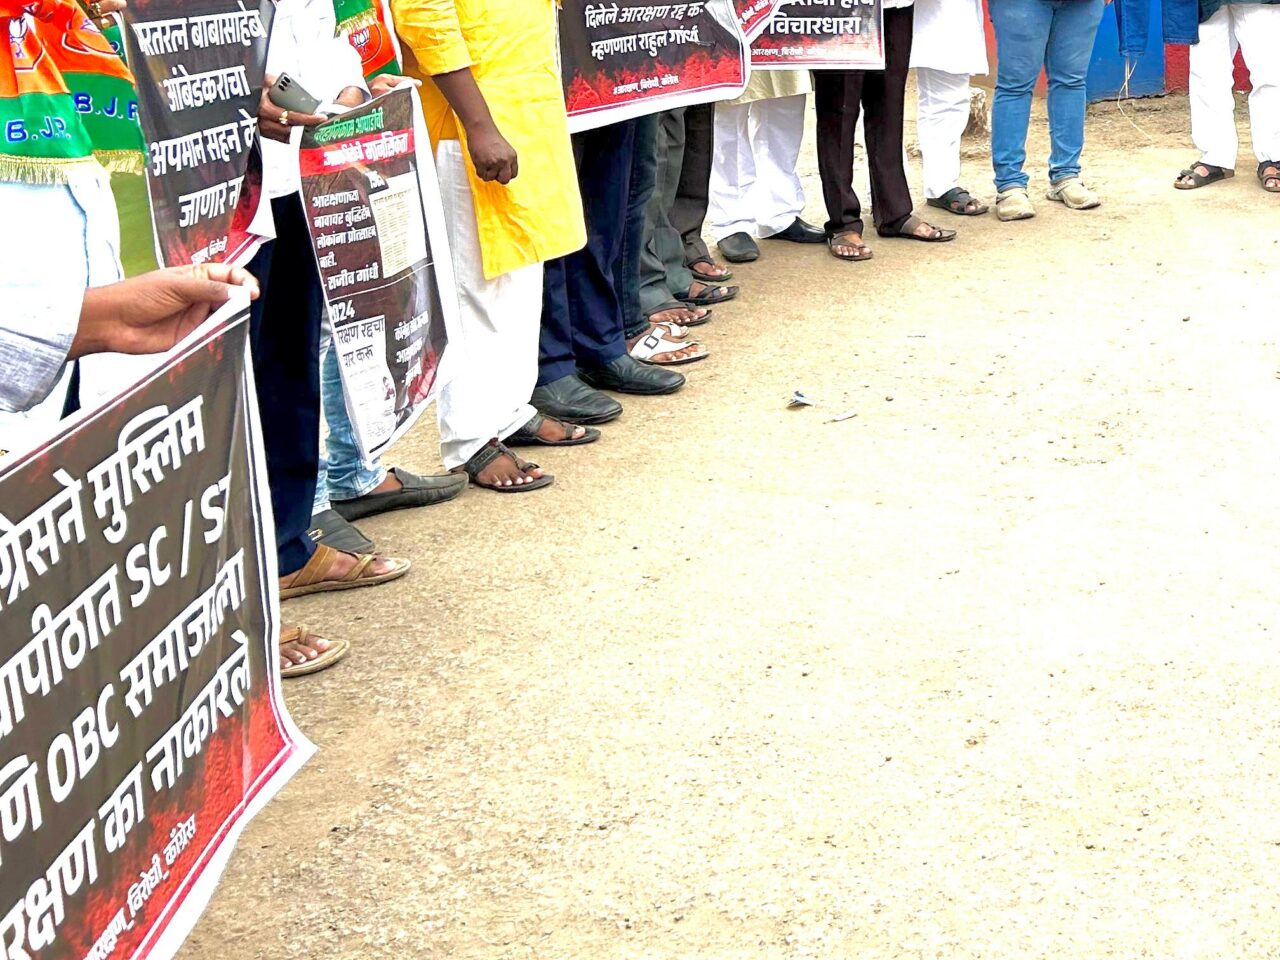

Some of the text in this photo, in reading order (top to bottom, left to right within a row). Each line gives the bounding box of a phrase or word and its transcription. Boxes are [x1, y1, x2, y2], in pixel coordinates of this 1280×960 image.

[188, 0, 267, 49] बाबासाहेब
[585, 2, 619, 28] दिलेले
[618, 5, 671, 24] आरक्षण
[670, 6, 687, 21] रद्द
[769, 11, 862, 35] विचारधारा
[591, 33, 637, 60] म्हणणारा
[638, 28, 668, 57] राहुल
[160, 64, 251, 112] आंबेडकराचा
[150, 130, 206, 177] अपमान
[203, 119, 243, 163] सहन
[178, 182, 228, 228] जाणार
[313, 213, 344, 229] नावावर
[316, 230, 347, 249] लोकांना
[327, 261, 380, 290] राजीव गांधी
[87, 394, 207, 544] मुस्लिम
[126, 525, 171, 608] SC
[46, 683, 120, 803] OBC
[119, 547, 247, 718] समाजाला
[98, 760, 146, 854] का
[145, 629, 251, 793] नाकारले
